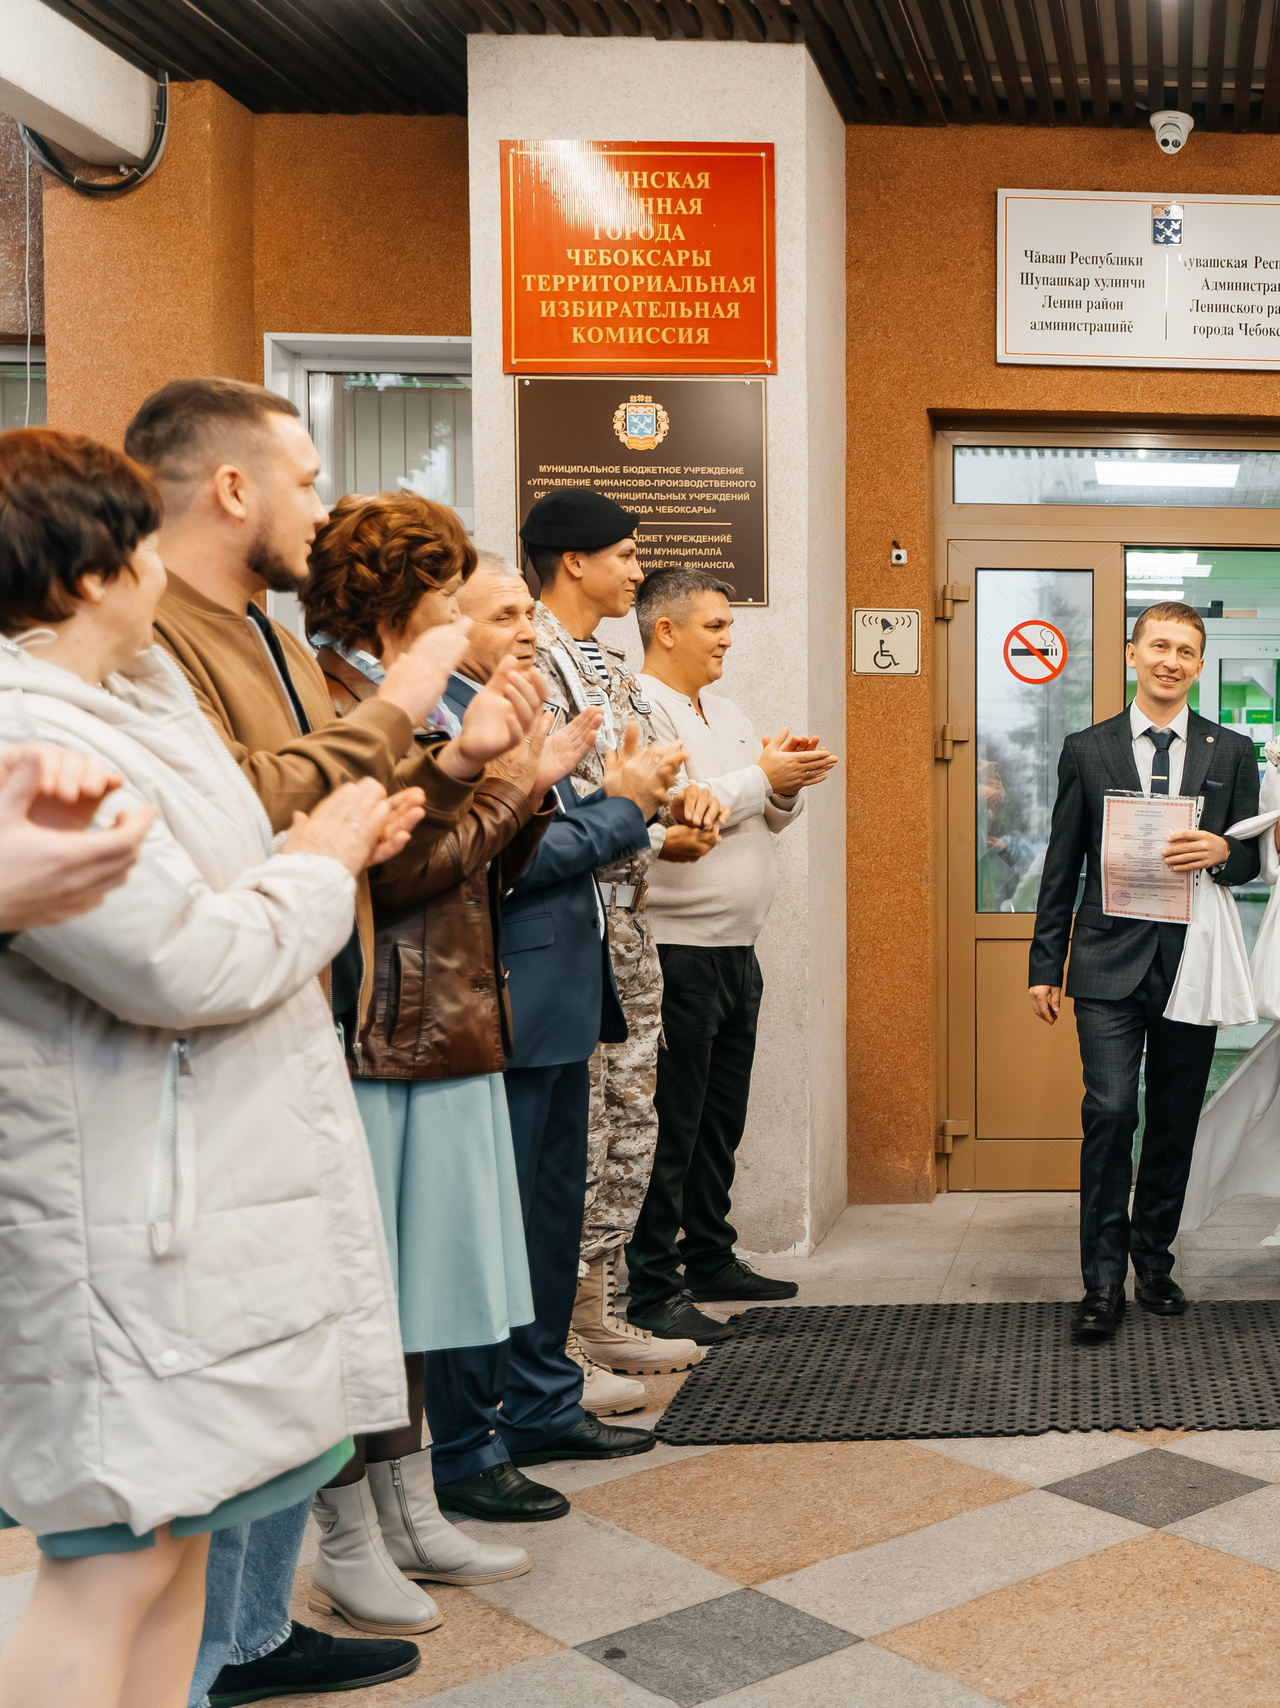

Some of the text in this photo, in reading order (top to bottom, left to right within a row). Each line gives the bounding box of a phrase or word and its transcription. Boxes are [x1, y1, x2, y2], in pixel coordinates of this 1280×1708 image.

[562, 171, 710, 189] ИНСКАЯ
[593, 223, 686, 244] ГОРОДА
[565, 249, 711, 267] ЧЕБОКСАРЫ
[1023, 249, 1144, 268] Чӑваш Республики
[521, 274, 756, 293] ТЕРРИТОРИАЛЬНАЯ
[1019, 272, 1146, 292] Шупашкар хулинчи
[539, 300, 741, 319] ИЗБИРАТЕЛЬНАЯ
[1041, 295, 1124, 314] Ленин район
[1189, 299, 1264, 316] Ленинского
[571, 326, 710, 344] КОМИССИЯ
[1192, 325, 1235, 339] города
[539, 465, 744, 475] МУНИЦИПАЛЬНОЕ БЮДЖЕТНОЕ УЧРЕЖДЕНИЕ
[527, 478, 757, 489] «УПРАВЛЕНИЕ ФИНАНСОВО-ПРОИЗВОДСТВЕННОГО
[604, 491, 686, 501] МУНИЦИПАЛЬНЫХ
[688, 491, 750, 502] УЧРЕЖДЕНИЙ
[619, 504, 717, 515] ОРОДА ЧЕБОКСАРЫ»
[684, 561, 735, 570] ФИНАНСПА
